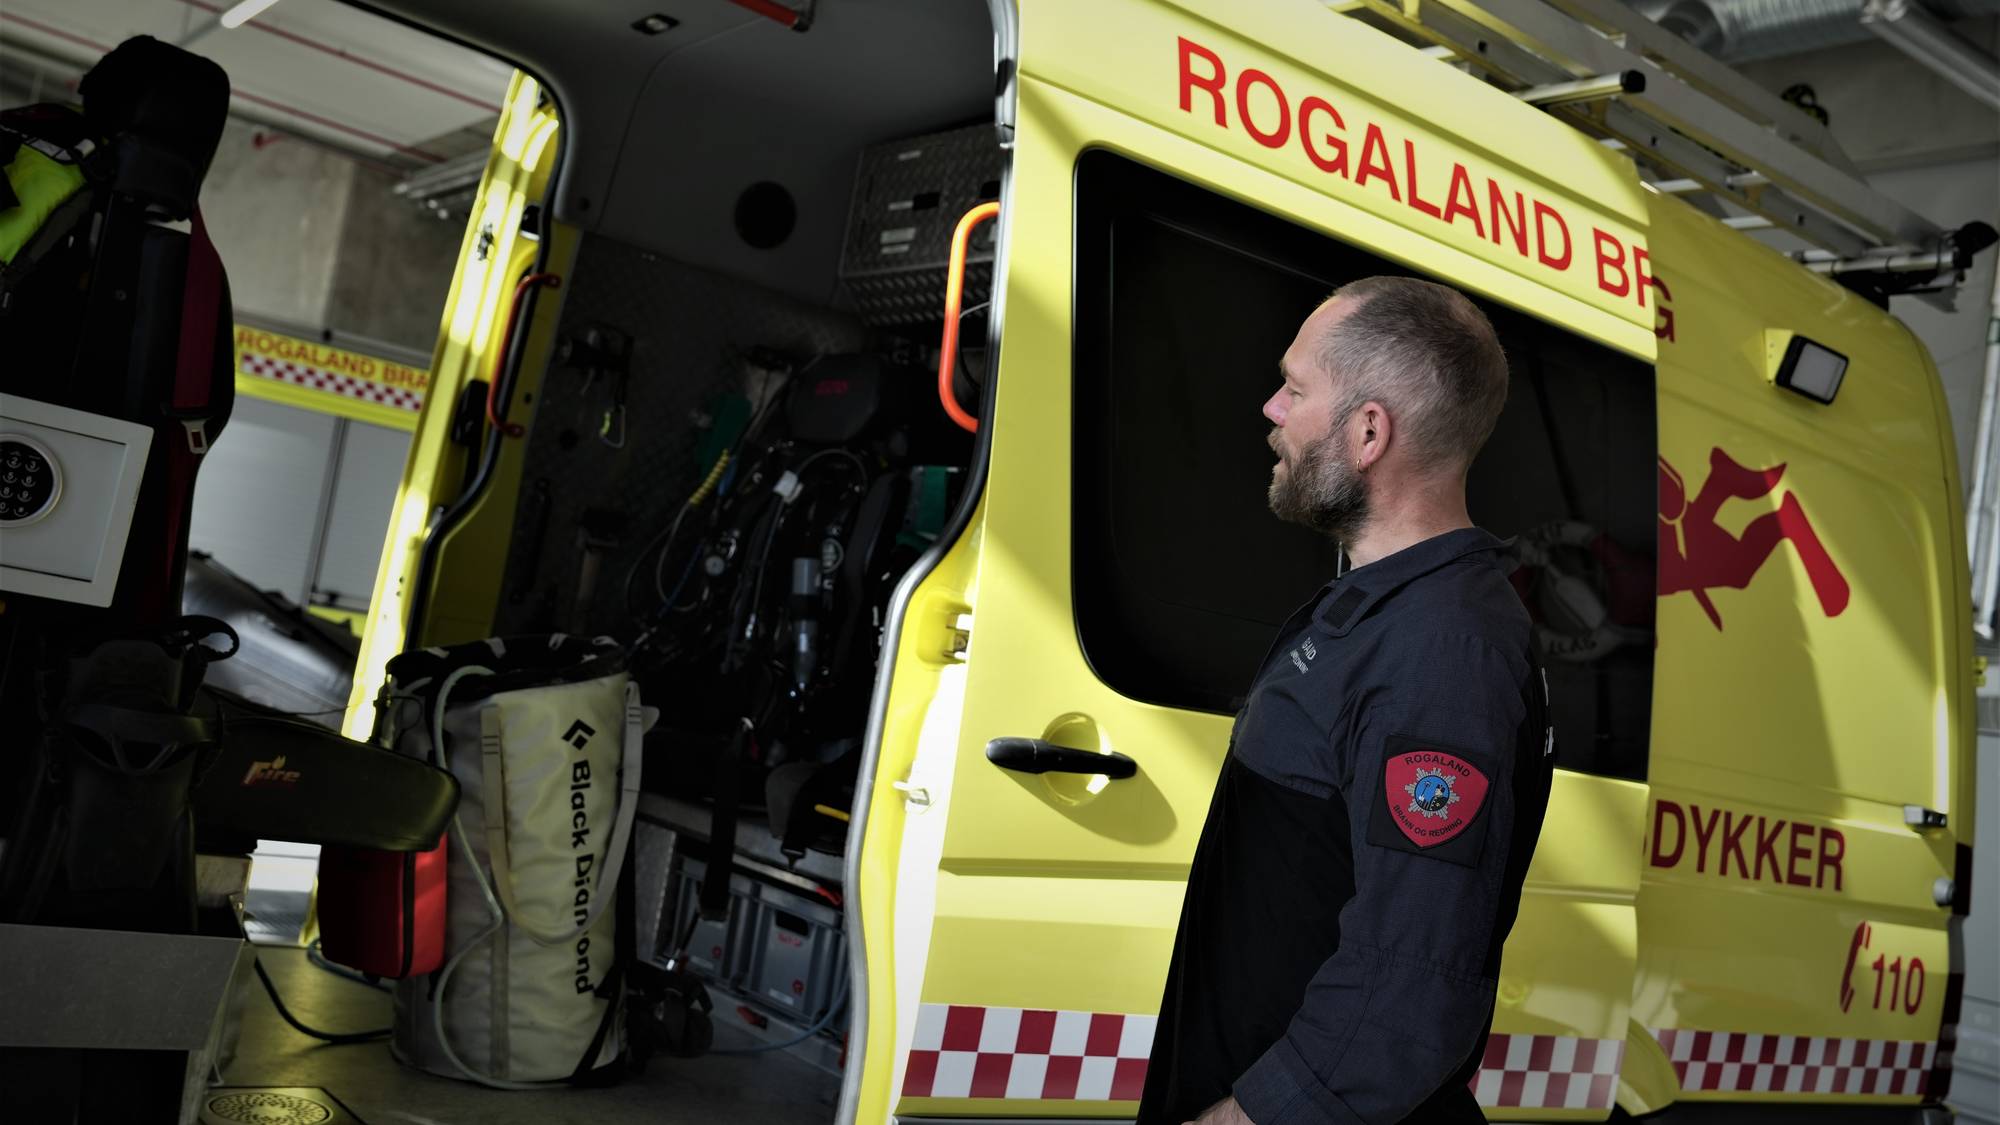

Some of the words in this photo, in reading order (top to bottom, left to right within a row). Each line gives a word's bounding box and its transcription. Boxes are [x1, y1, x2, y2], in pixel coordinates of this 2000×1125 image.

[1178, 36, 1572, 271] ROGALAND
[238, 330, 376, 377] ROGALAND
[1404, 753, 1471, 777] ROGALAND
[570, 759, 591, 849] Black
[1392, 804, 1414, 830] BRANN
[1414, 826, 1427, 837] OG
[1429, 818, 1463, 838] REDNING
[1643, 799, 1846, 891] DYKKER
[1872, 953, 1925, 1016] 110
